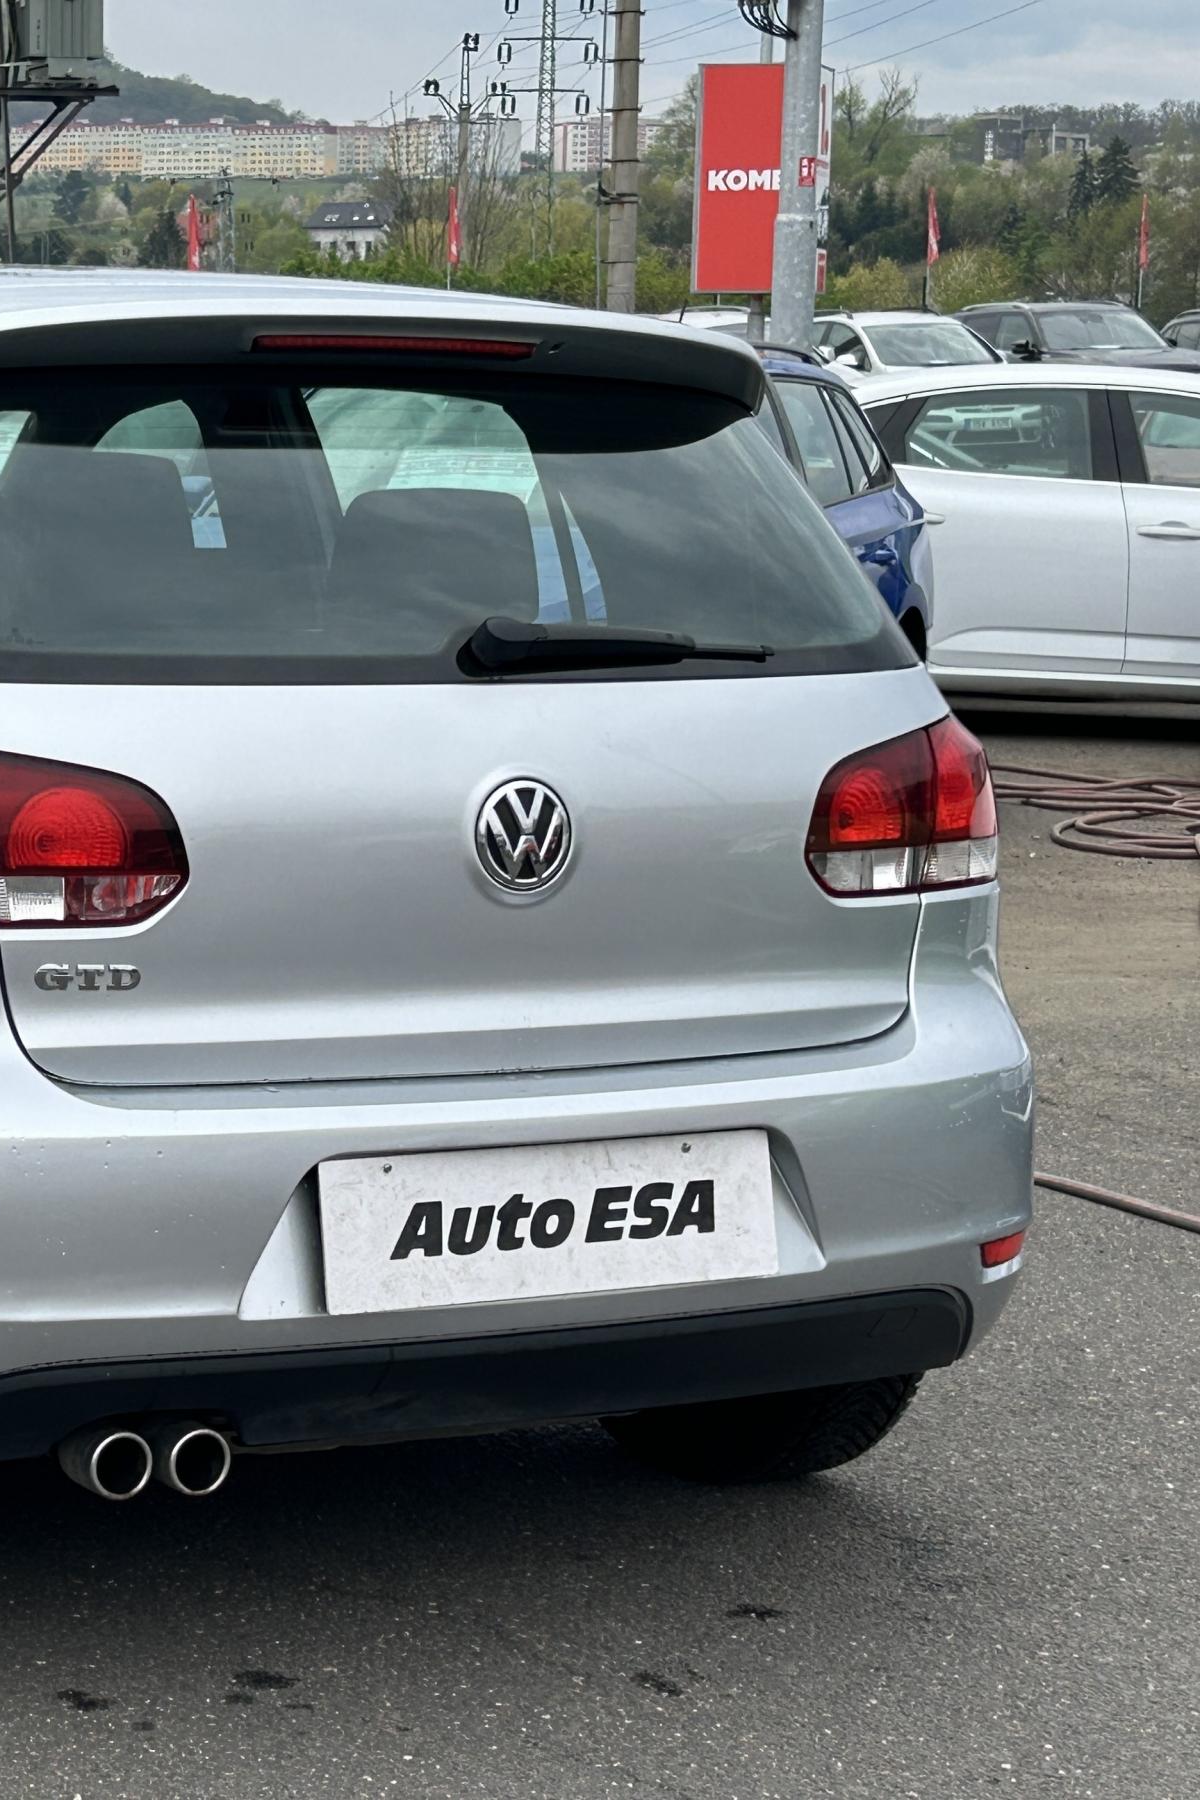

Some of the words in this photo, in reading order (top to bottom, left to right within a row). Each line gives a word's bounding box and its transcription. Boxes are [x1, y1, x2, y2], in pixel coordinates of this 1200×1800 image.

[34, 963, 141, 991] GTD
[390, 1194, 575, 1260] Auto
[585, 1179, 715, 1243] ESA
